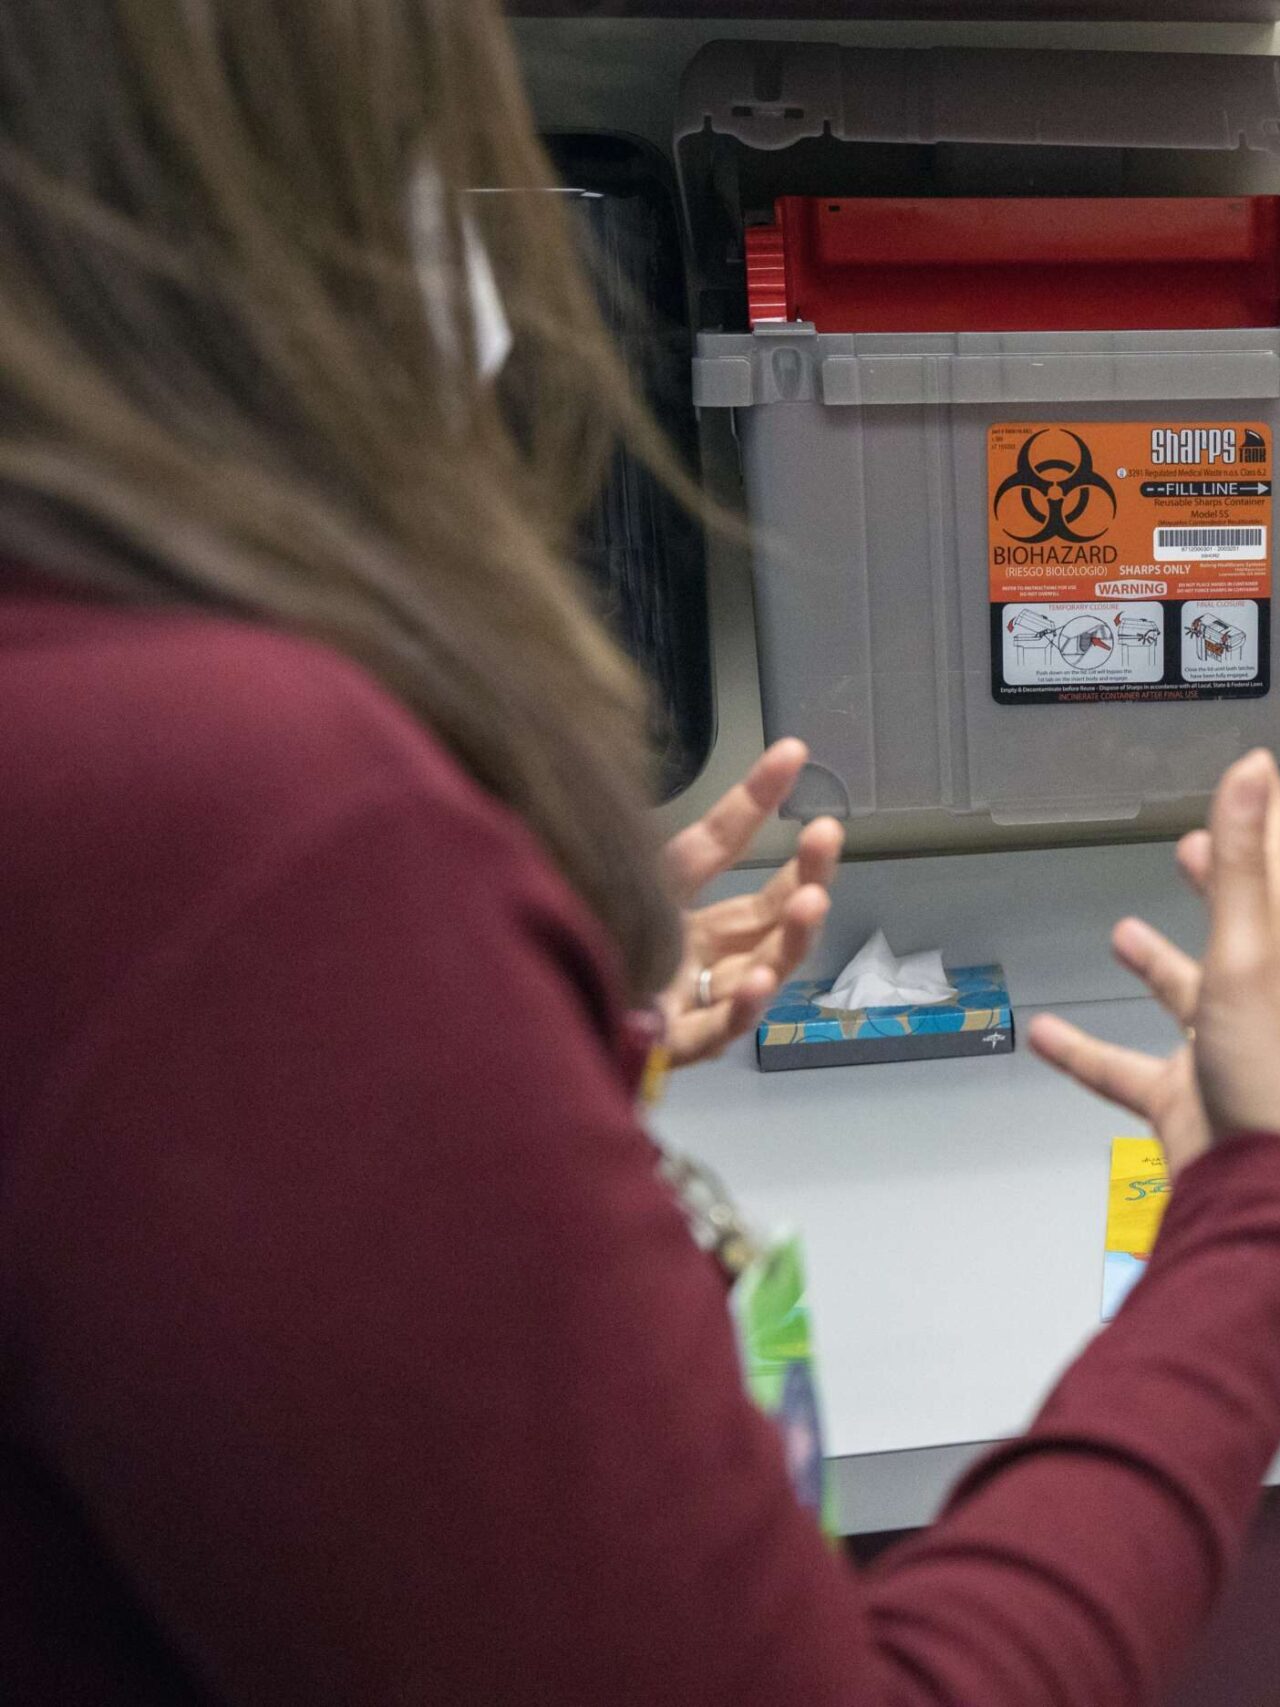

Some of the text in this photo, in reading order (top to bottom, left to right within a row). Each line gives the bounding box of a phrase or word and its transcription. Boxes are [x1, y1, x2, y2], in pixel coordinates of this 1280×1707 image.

[1166, 482, 1239, 495] FILL LINE
[1154, 497, 1265, 509] Reusable Sharps Container
[1191, 510, 1218, 518] Model
[993, 546, 1117, 565] BIOHAZARD
[1005, 566, 1044, 578] (RIESGO
[1119, 564, 1191, 575] SHARPS ONLY
[1099, 583, 1164, 594] WARNING
